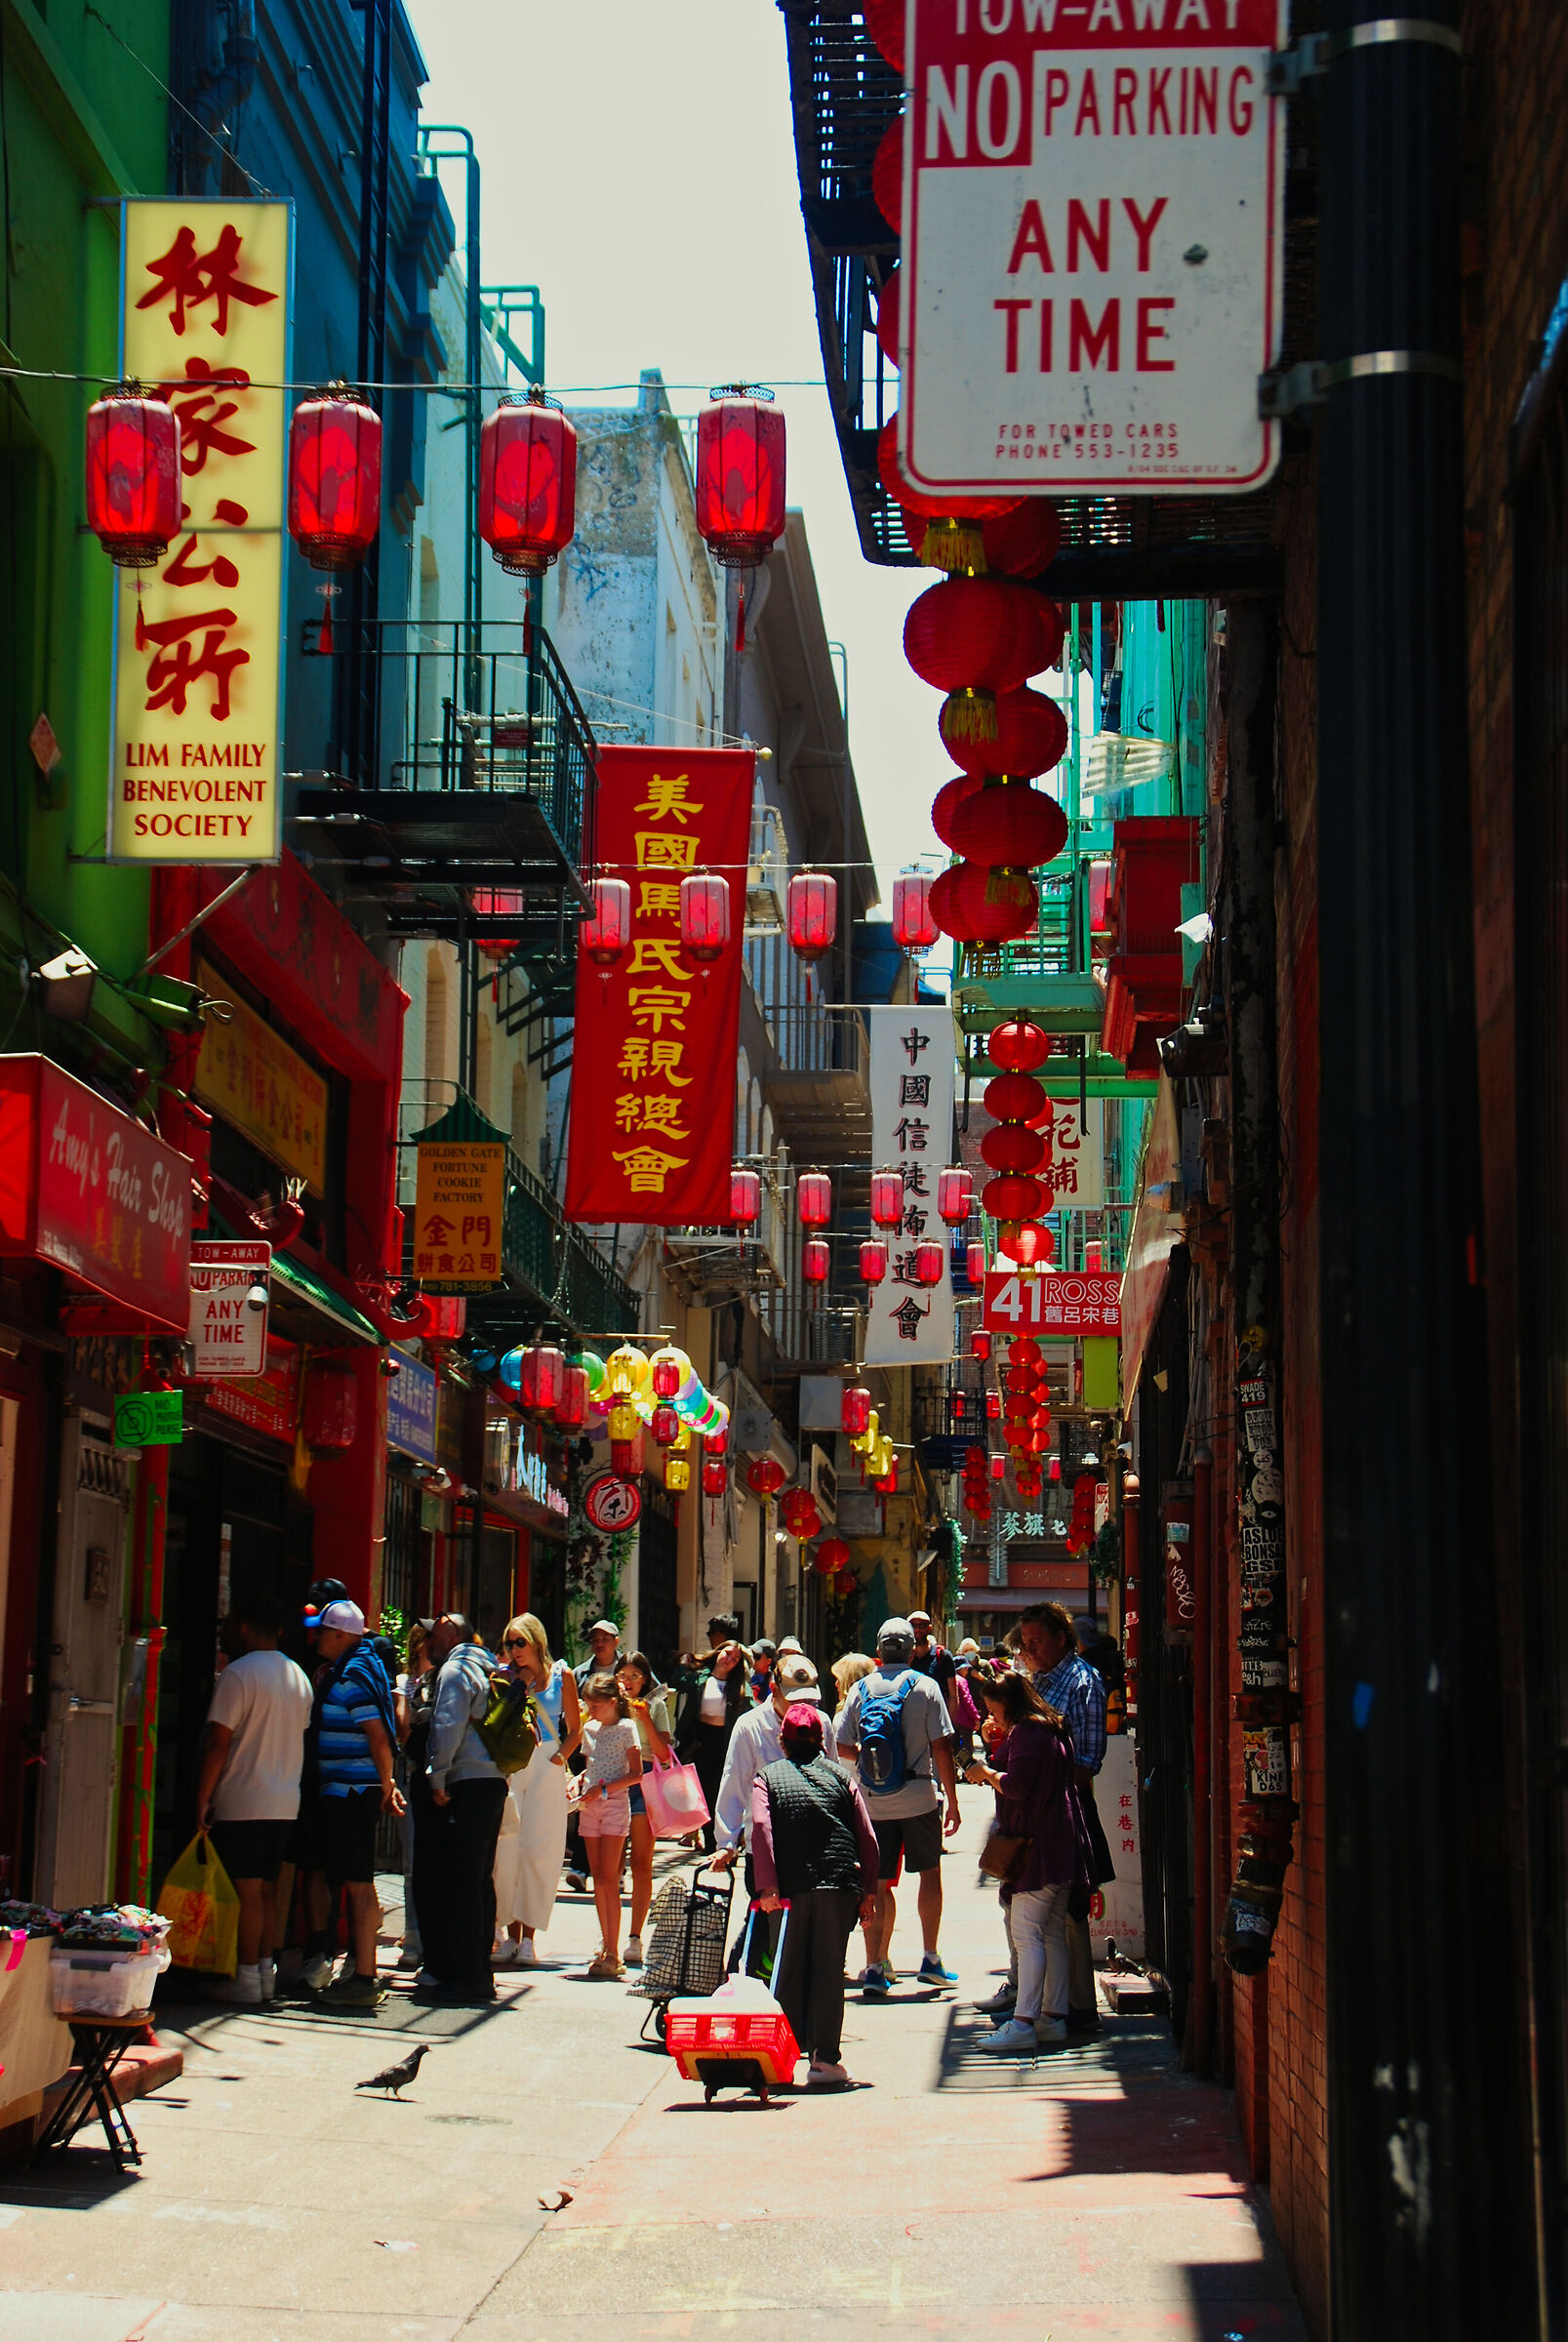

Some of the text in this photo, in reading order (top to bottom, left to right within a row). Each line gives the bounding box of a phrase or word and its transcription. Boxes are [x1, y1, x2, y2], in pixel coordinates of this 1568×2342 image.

[924, 61, 1254, 159] NO PARKING
[1007, 197, 1169, 274] ANY
[993, 297, 1176, 373] TIME
[999, 423, 1177, 438] FOR TOWED CARS
[995, 443, 1178, 459] PHONE 553-1235
[126, 743, 265, 767] LIM FAMILY
[123, 780, 266, 802] BENEVOLENT
[135, 814, 253, 836] SOCIETY
[421, 1148, 501, 1158] GOLDEN GATE
[49, 1097, 183, 1254] Amy's Hair Shop
[432, 1162, 487, 1172] FORTUNE
[437, 1177, 481, 1188] COOKIE
[432, 1191, 484, 1203] FACTORY
[422, 1214, 492, 1247] 金門
[440, 1280, 492, 1292] 781-3856
[991, 1276, 1119, 1322] 41 ROSS
[206, 1300, 244, 1319] ANY
[203, 1324, 244, 1344] TIME
[155, 1398, 170, 1410] NO
[1241, 1392, 1266, 1403] 419
